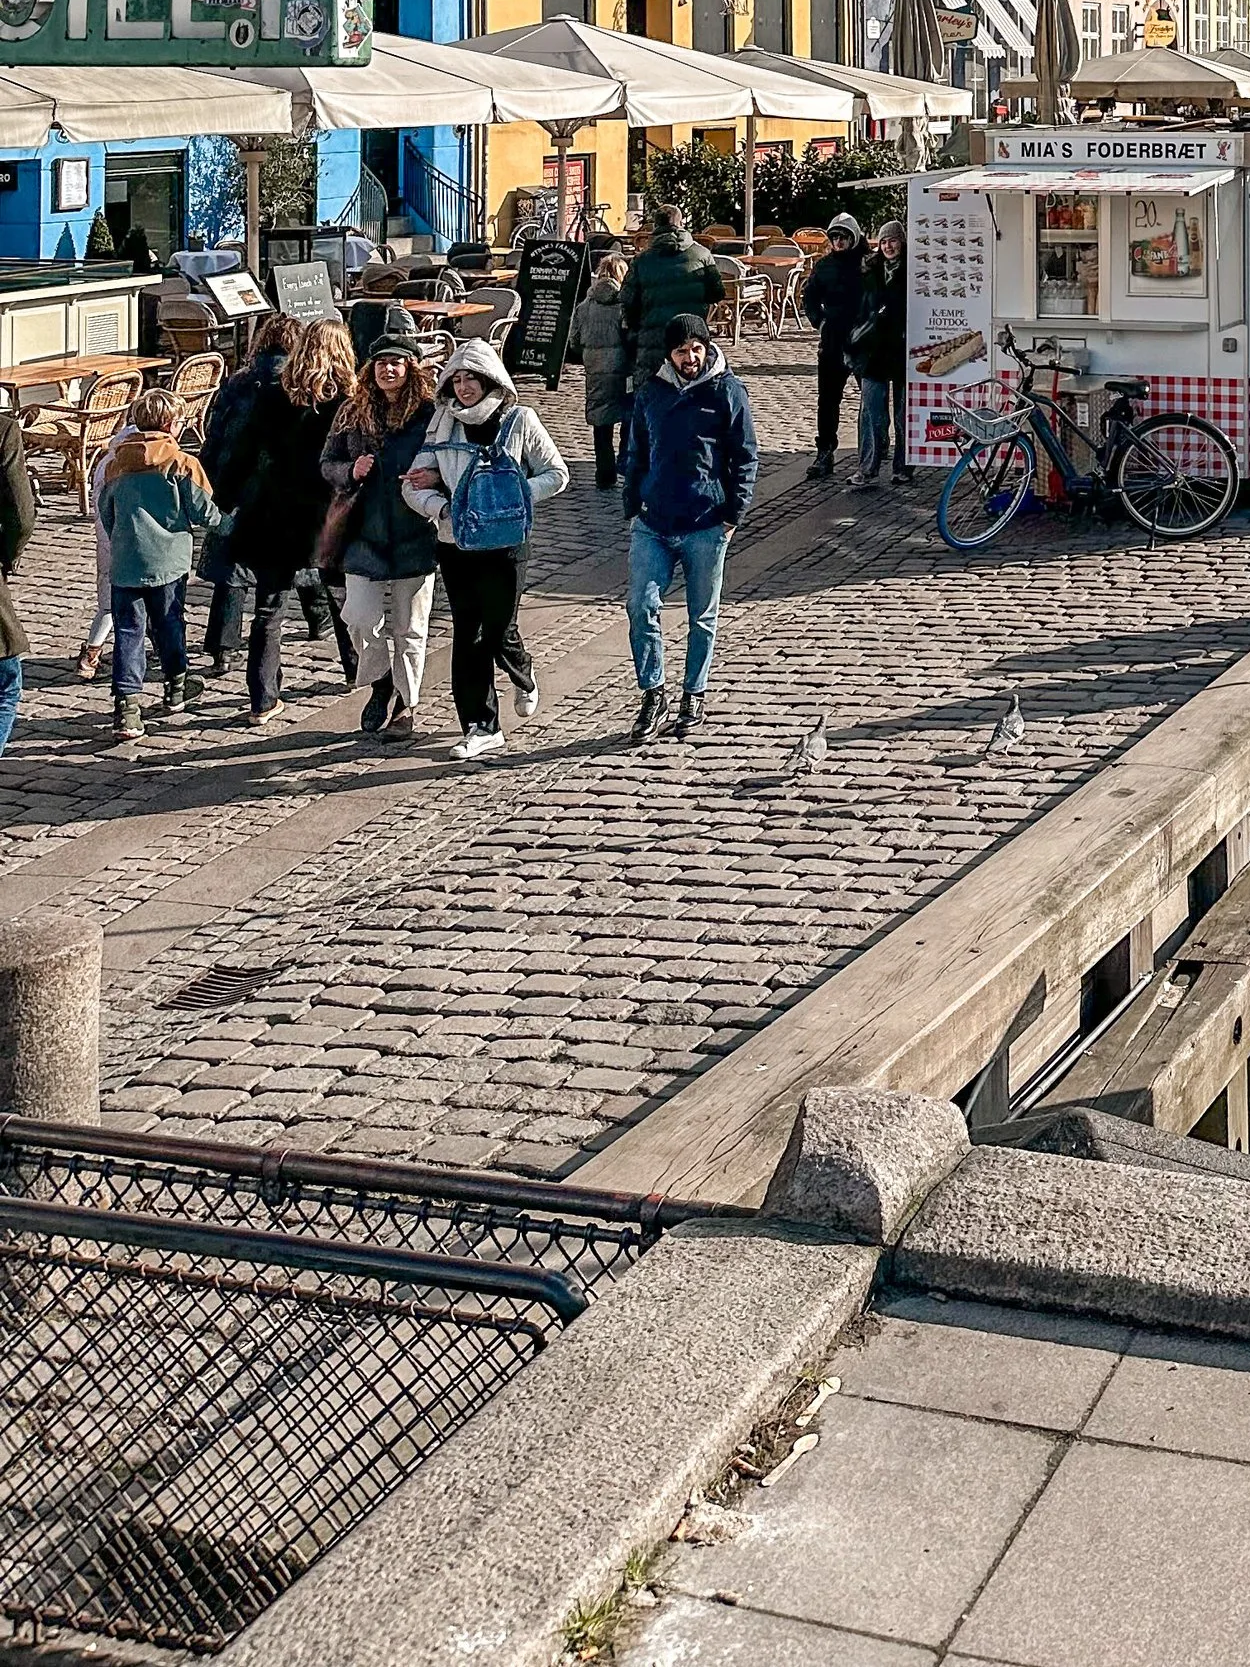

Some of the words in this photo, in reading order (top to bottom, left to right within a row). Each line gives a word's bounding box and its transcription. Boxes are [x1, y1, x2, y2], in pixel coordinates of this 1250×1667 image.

[1087, 142, 1207, 159] FODERBRÆT
[931, 308, 966, 318] KÆMPE
[928, 317, 968, 326] HOTDOG
